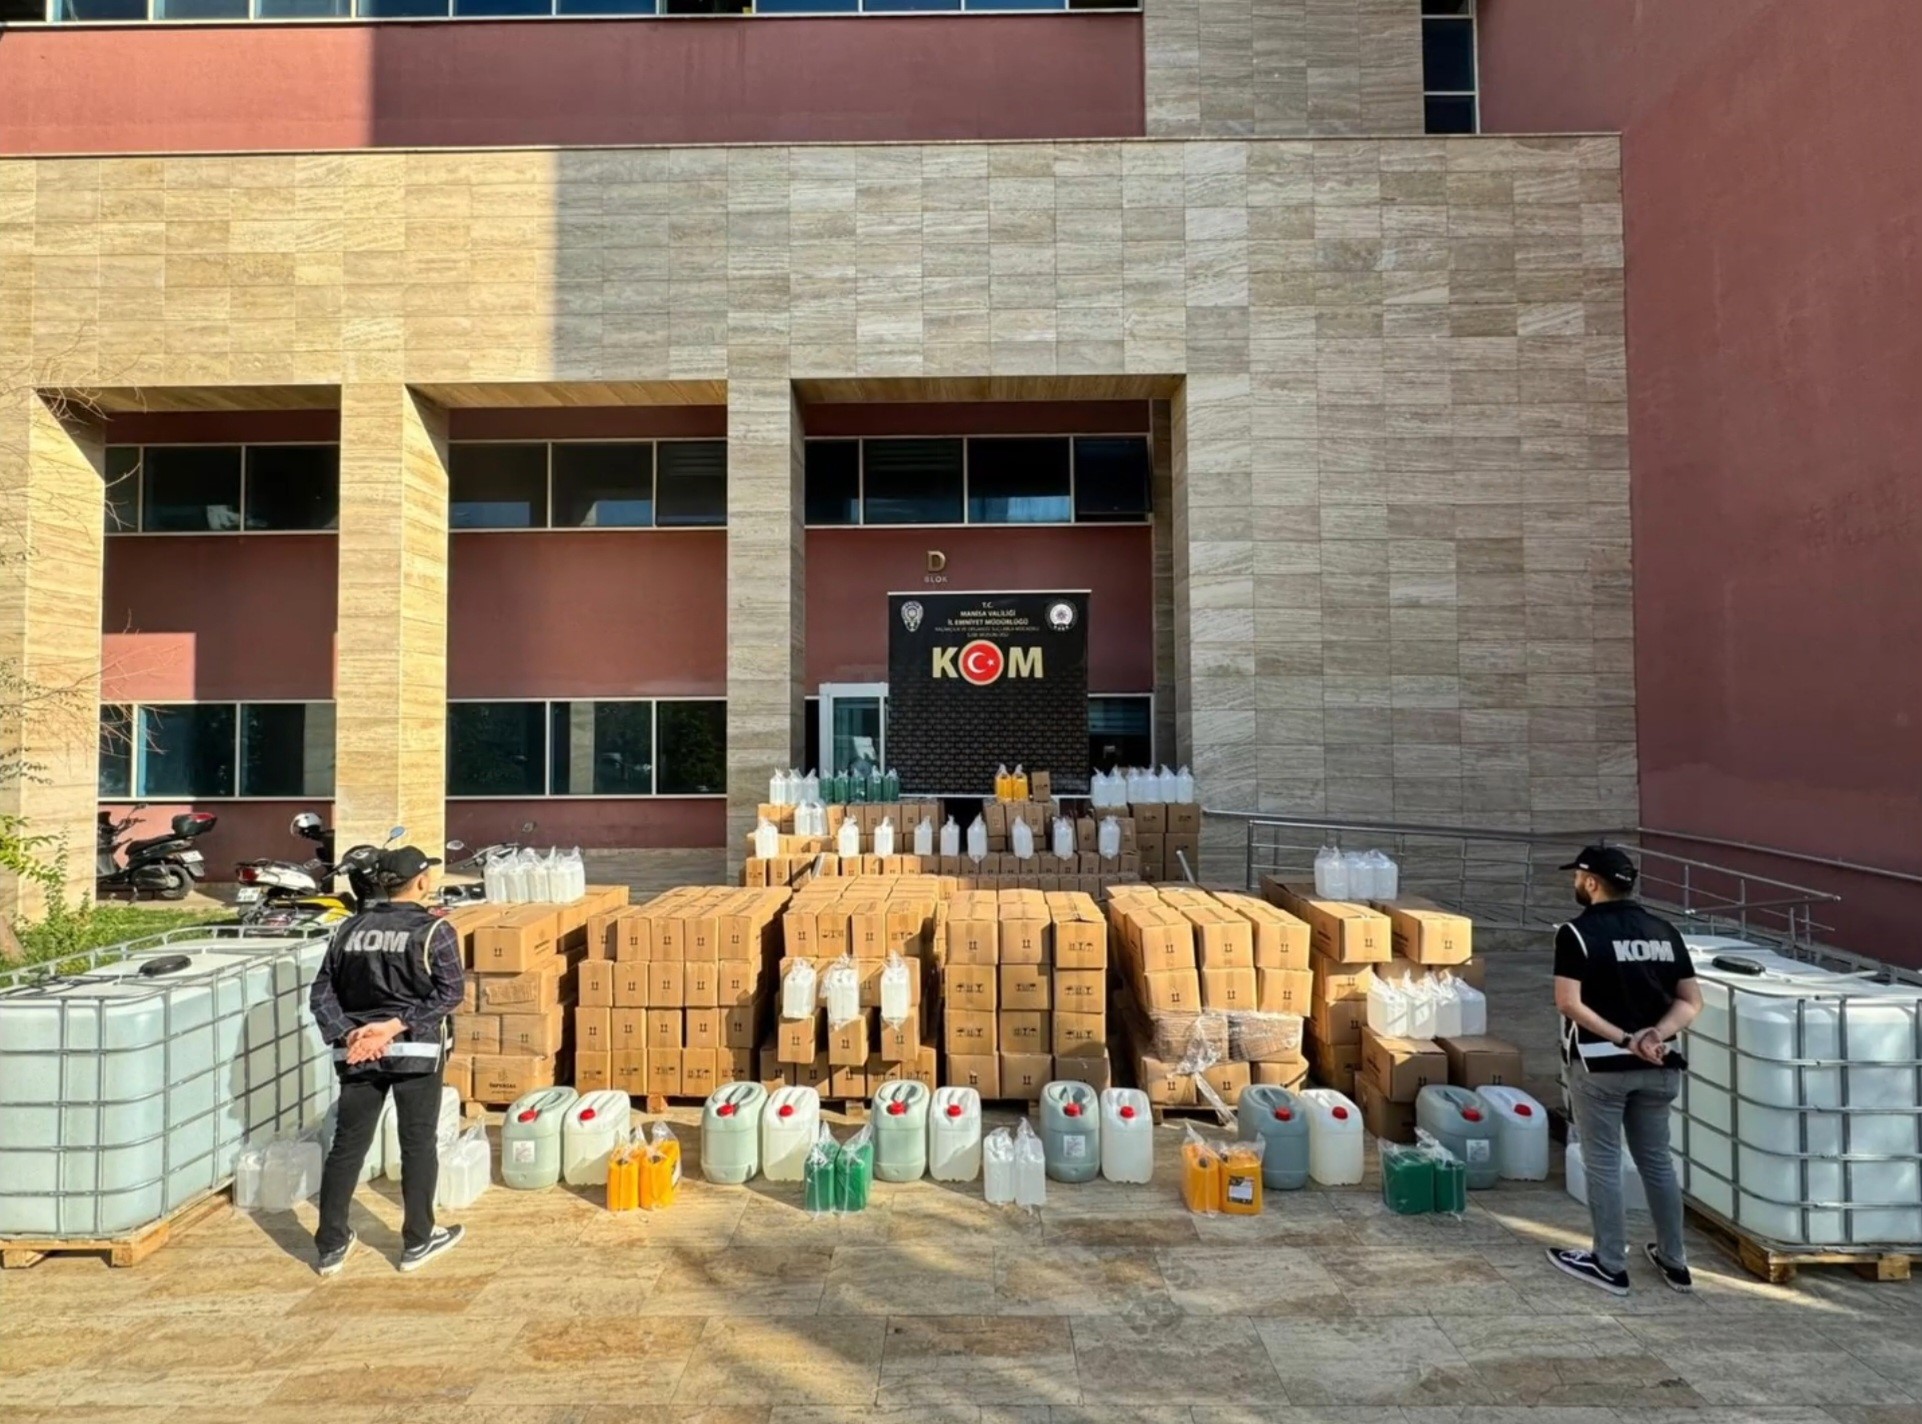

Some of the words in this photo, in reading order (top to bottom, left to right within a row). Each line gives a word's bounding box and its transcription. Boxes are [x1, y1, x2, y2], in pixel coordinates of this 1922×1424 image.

[927, 550, 946, 571] D
[344, 929, 411, 953] KOM
[1612, 940, 1675, 963] KOM
